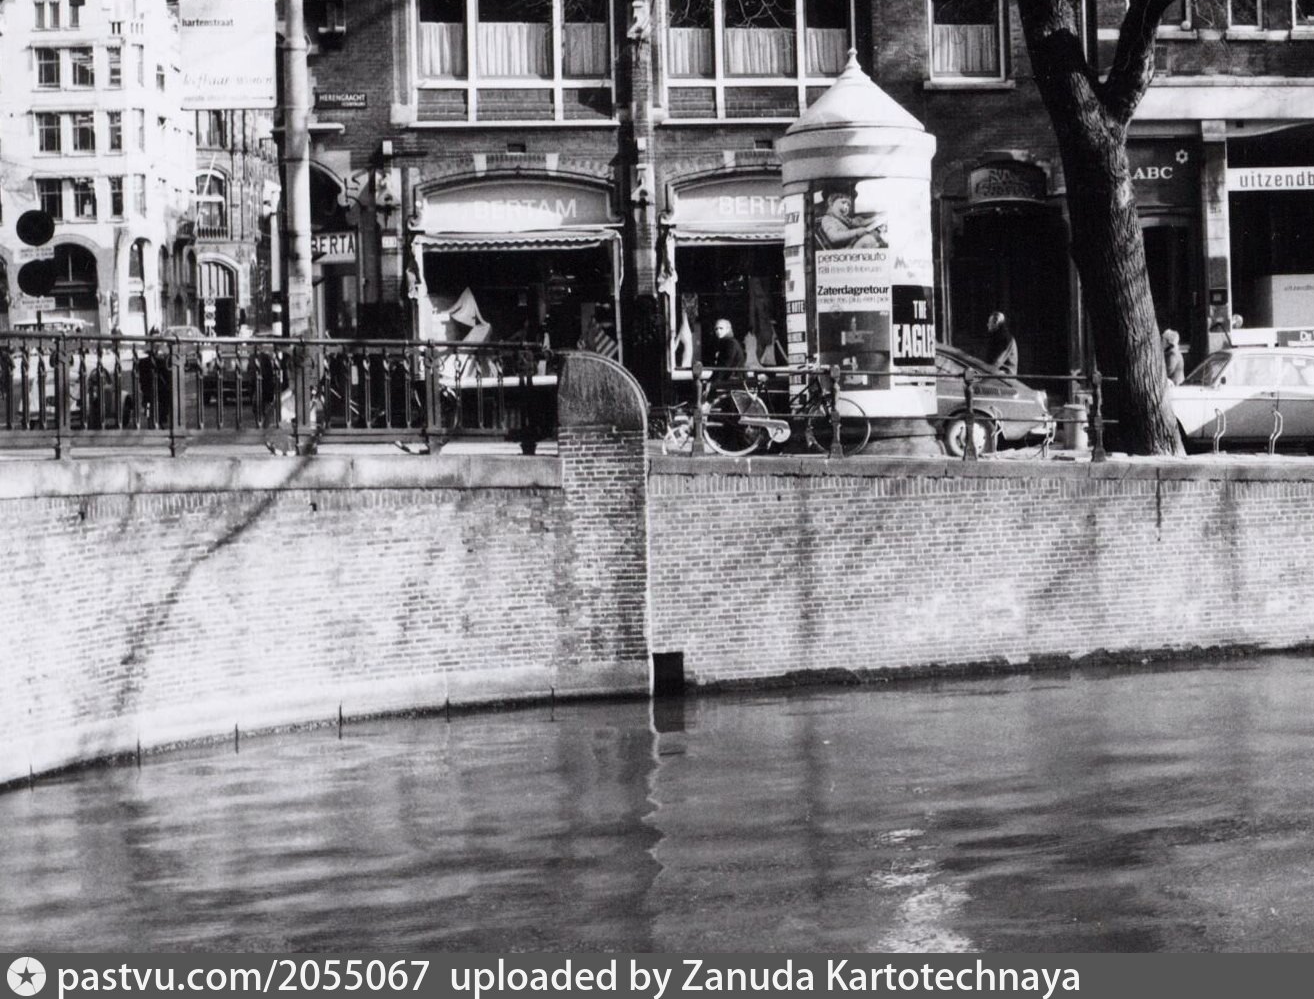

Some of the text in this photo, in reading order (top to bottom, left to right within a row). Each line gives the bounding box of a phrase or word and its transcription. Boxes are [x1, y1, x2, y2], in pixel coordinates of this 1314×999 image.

[182, 19, 234, 27] hartenstraat
[1132, 166, 1173, 180] ABC
[474, 198, 577, 220] BERTAM
[818, 251, 886, 264] personenauto
[818, 285, 889, 297] Zaterdagretour
[913, 300, 927, 319] THE
